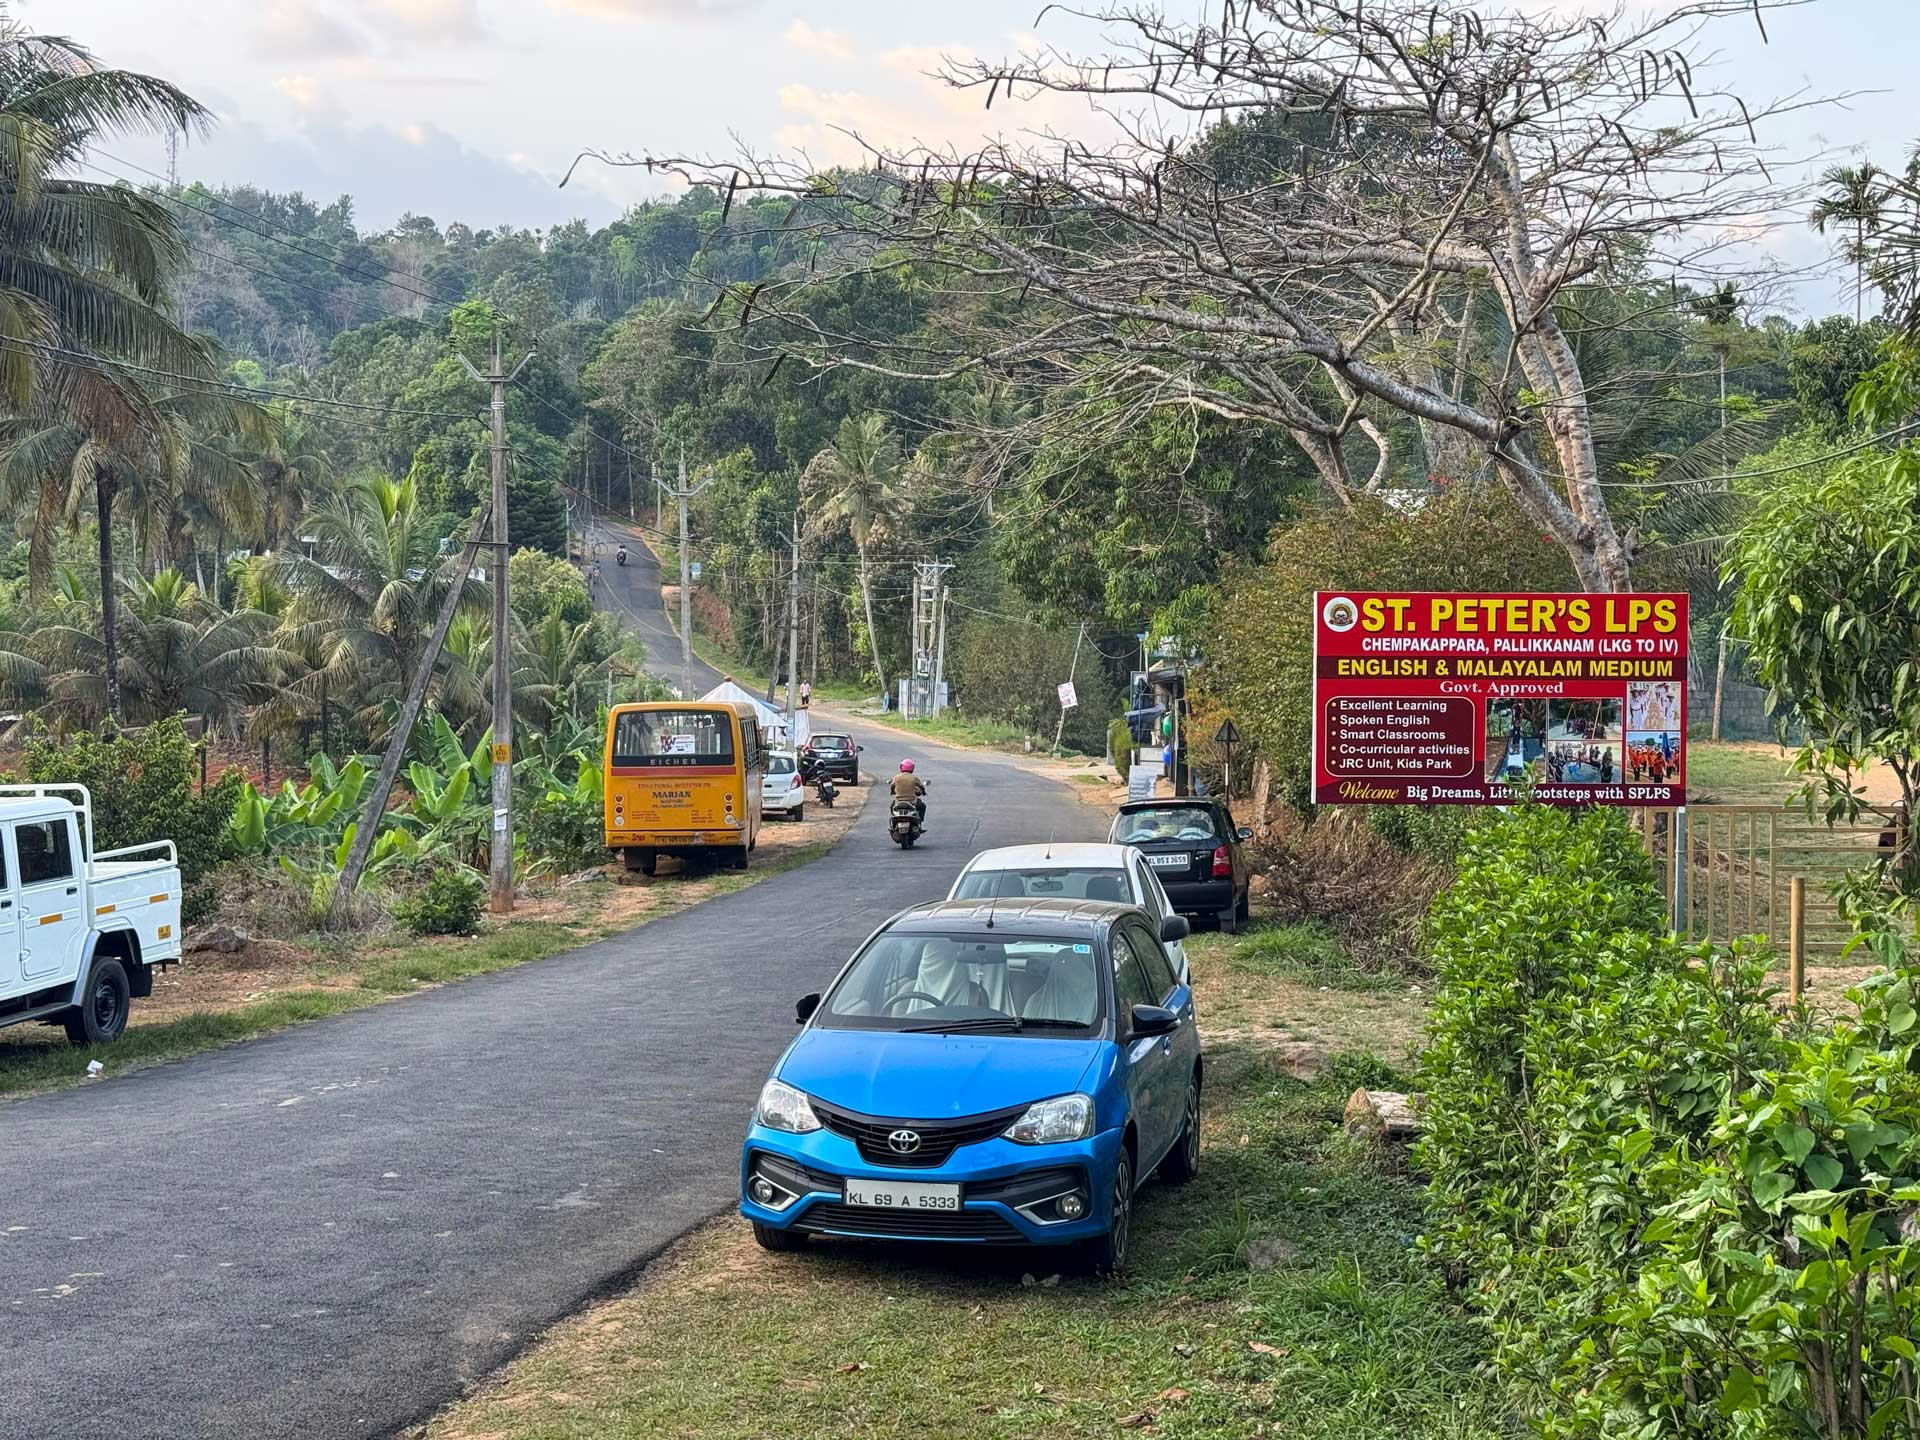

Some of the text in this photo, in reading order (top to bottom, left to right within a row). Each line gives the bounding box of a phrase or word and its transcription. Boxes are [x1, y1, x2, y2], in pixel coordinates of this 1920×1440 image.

[1361, 598, 1678, 634] ST. PETER'S LPS
[1362, 637, 1678, 656] CHEMPAKAPPARA, PALLIKKANAM (LKG TO IV)
[1337, 659, 1673, 677] ENGLISH & MALAYALAM MEDIUM
[1440, 680, 1564, 697] Govt. Approved
[1339, 700, 1448, 713] Excellent Learning
[1339, 714, 1430, 728] Spoken English
[1339, 729, 1446, 740] Smart Classrooms
[1339, 743, 1471, 755] Co-curricular activities
[1339, 758, 1453, 770] JRC Unit, Kids Park
[1338, 780, 1400, 800] Welcome
[1406, 785, 1428, 801] Big
[1431, 786, 1485, 801] Dreams,
[1595, 787, 1624, 799] with
[1628, 787, 1671, 800] SPLPS
[849, 1192, 956, 1209] KL 69 A 5333
